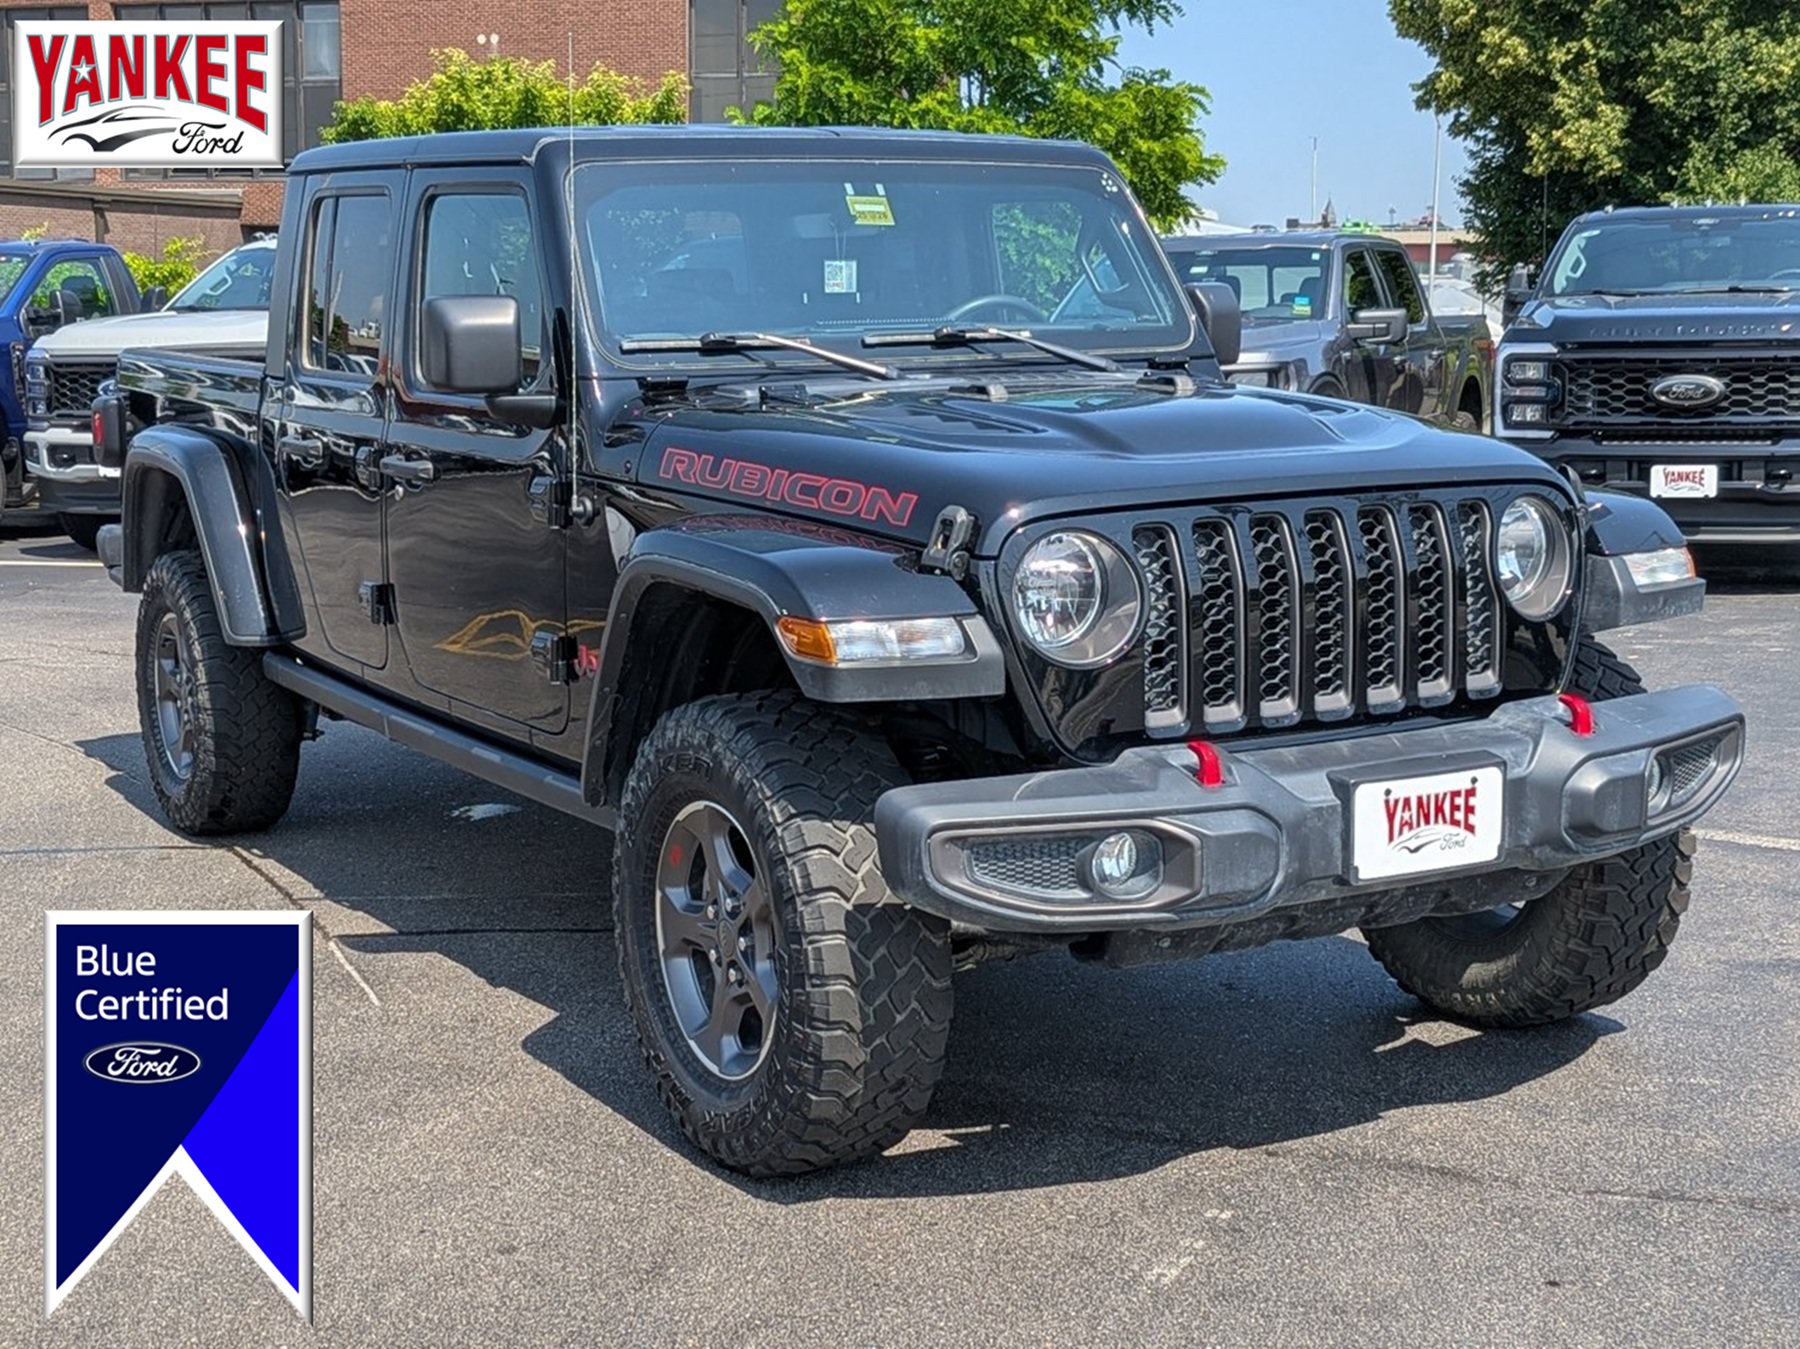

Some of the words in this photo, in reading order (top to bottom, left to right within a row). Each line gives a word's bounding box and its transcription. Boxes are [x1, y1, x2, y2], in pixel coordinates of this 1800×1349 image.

[1668, 384, 1705, 399] Ford
[659, 447, 919, 527] RUBICON
[1663, 469, 1705, 487] YANKEE
[1384, 786, 1477, 846] YANKEE
[1440, 833, 1468, 850] Ford
